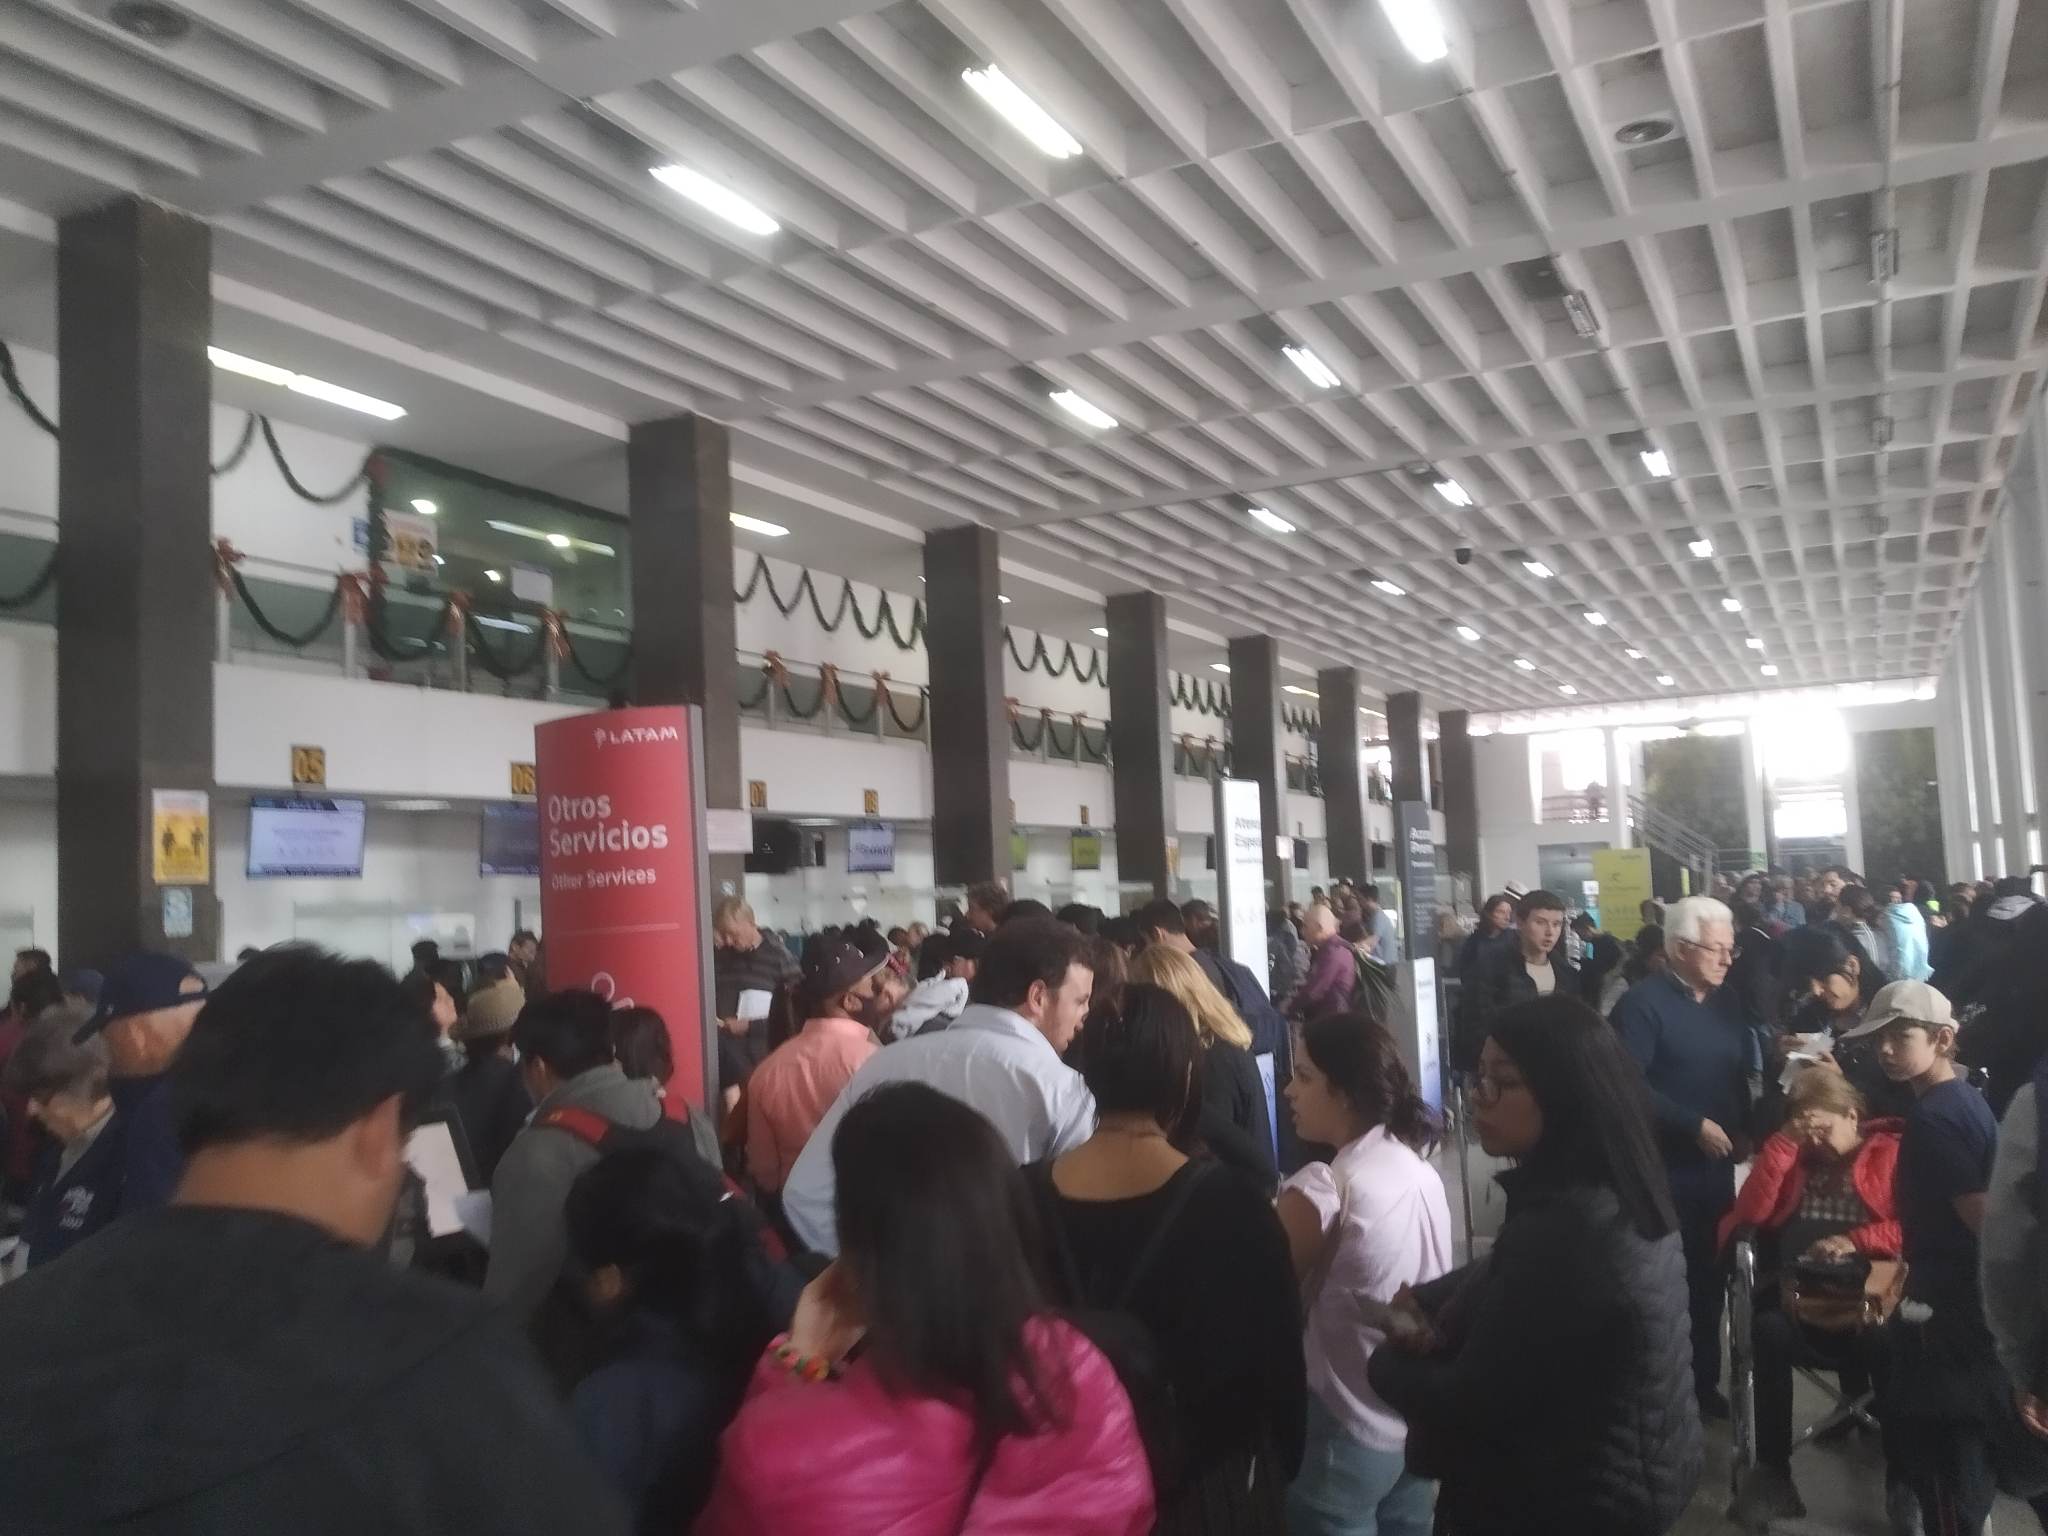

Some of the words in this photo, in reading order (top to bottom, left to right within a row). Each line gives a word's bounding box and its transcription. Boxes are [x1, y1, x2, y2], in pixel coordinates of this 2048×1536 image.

[609, 727, 679, 744] LATAM
[548, 794, 612, 823] Otros
[549, 819, 669, 858] Servicios
[586, 866, 656, 888] Services
